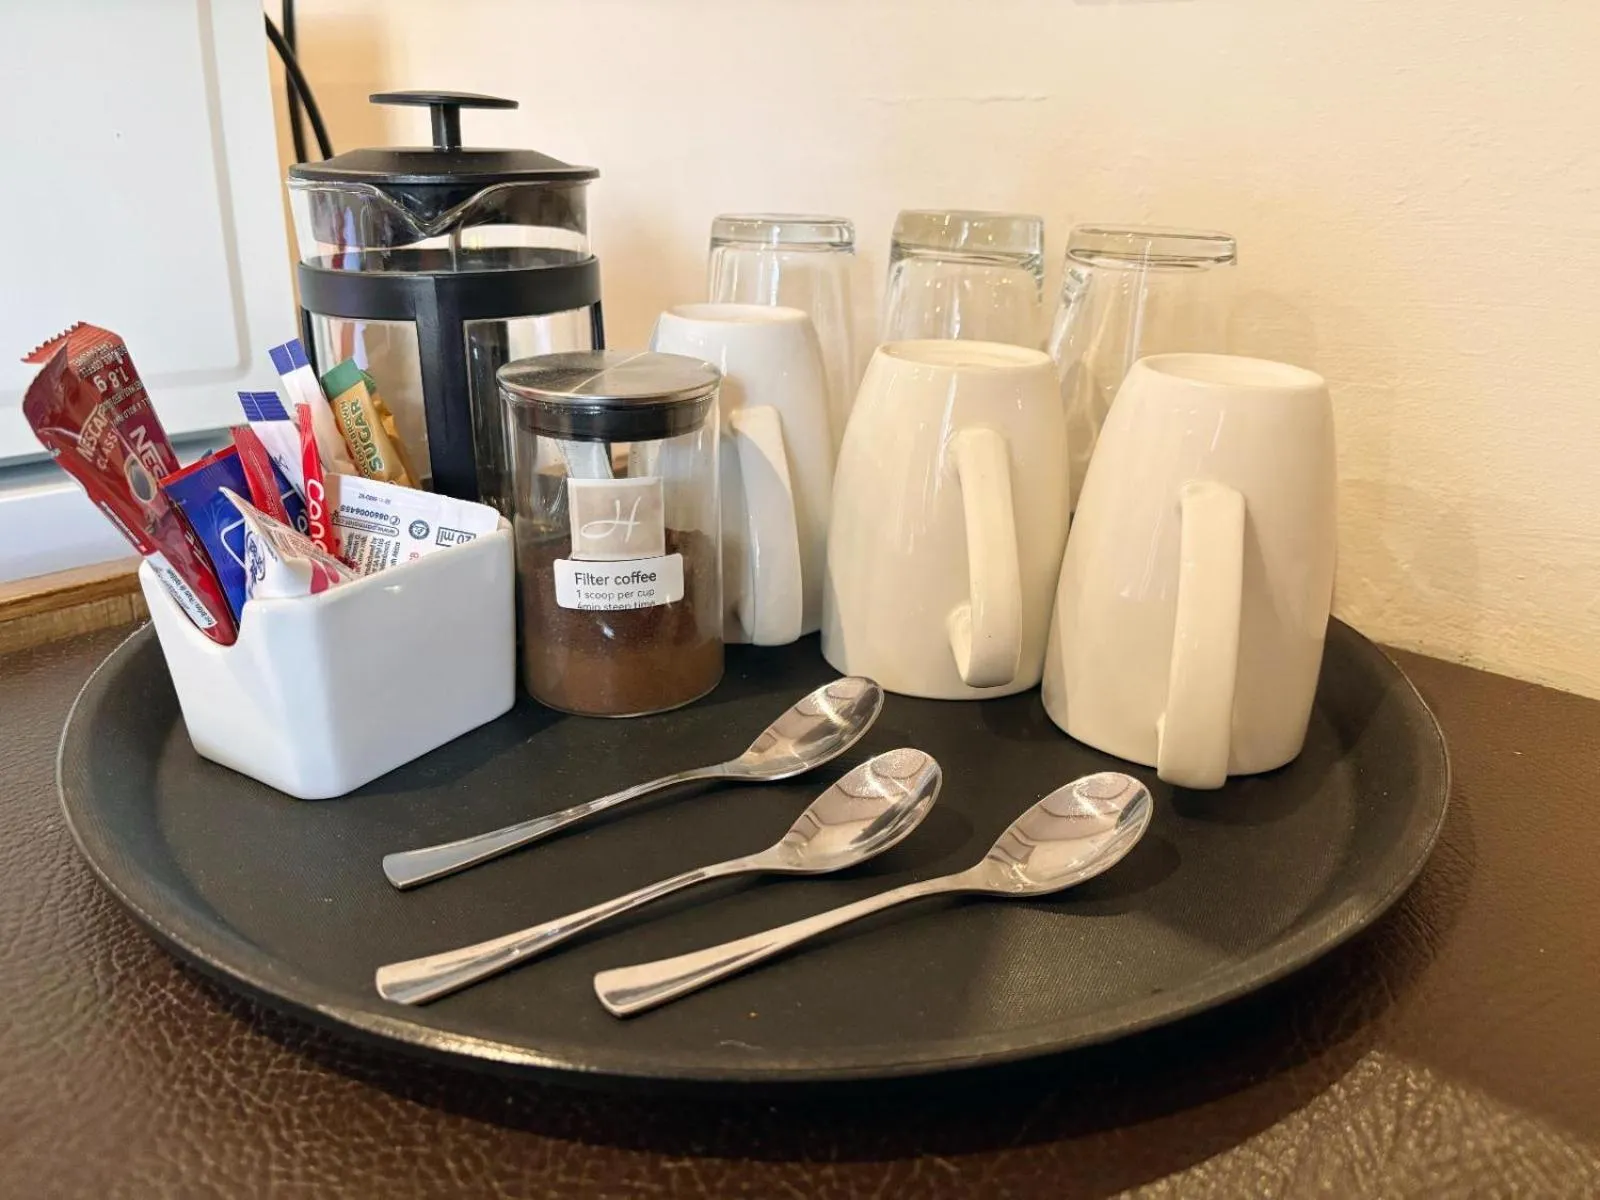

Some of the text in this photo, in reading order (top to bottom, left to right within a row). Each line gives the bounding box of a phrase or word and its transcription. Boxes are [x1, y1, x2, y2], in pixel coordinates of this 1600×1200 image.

[93, 365, 130, 393] 1.8 g
[351, 398, 386, 473] SUGAR
[580, 495, 642, 544] H
[574, 570, 657, 586] Filter coffee
[576, 588, 655, 601] 1 scoop per cup
